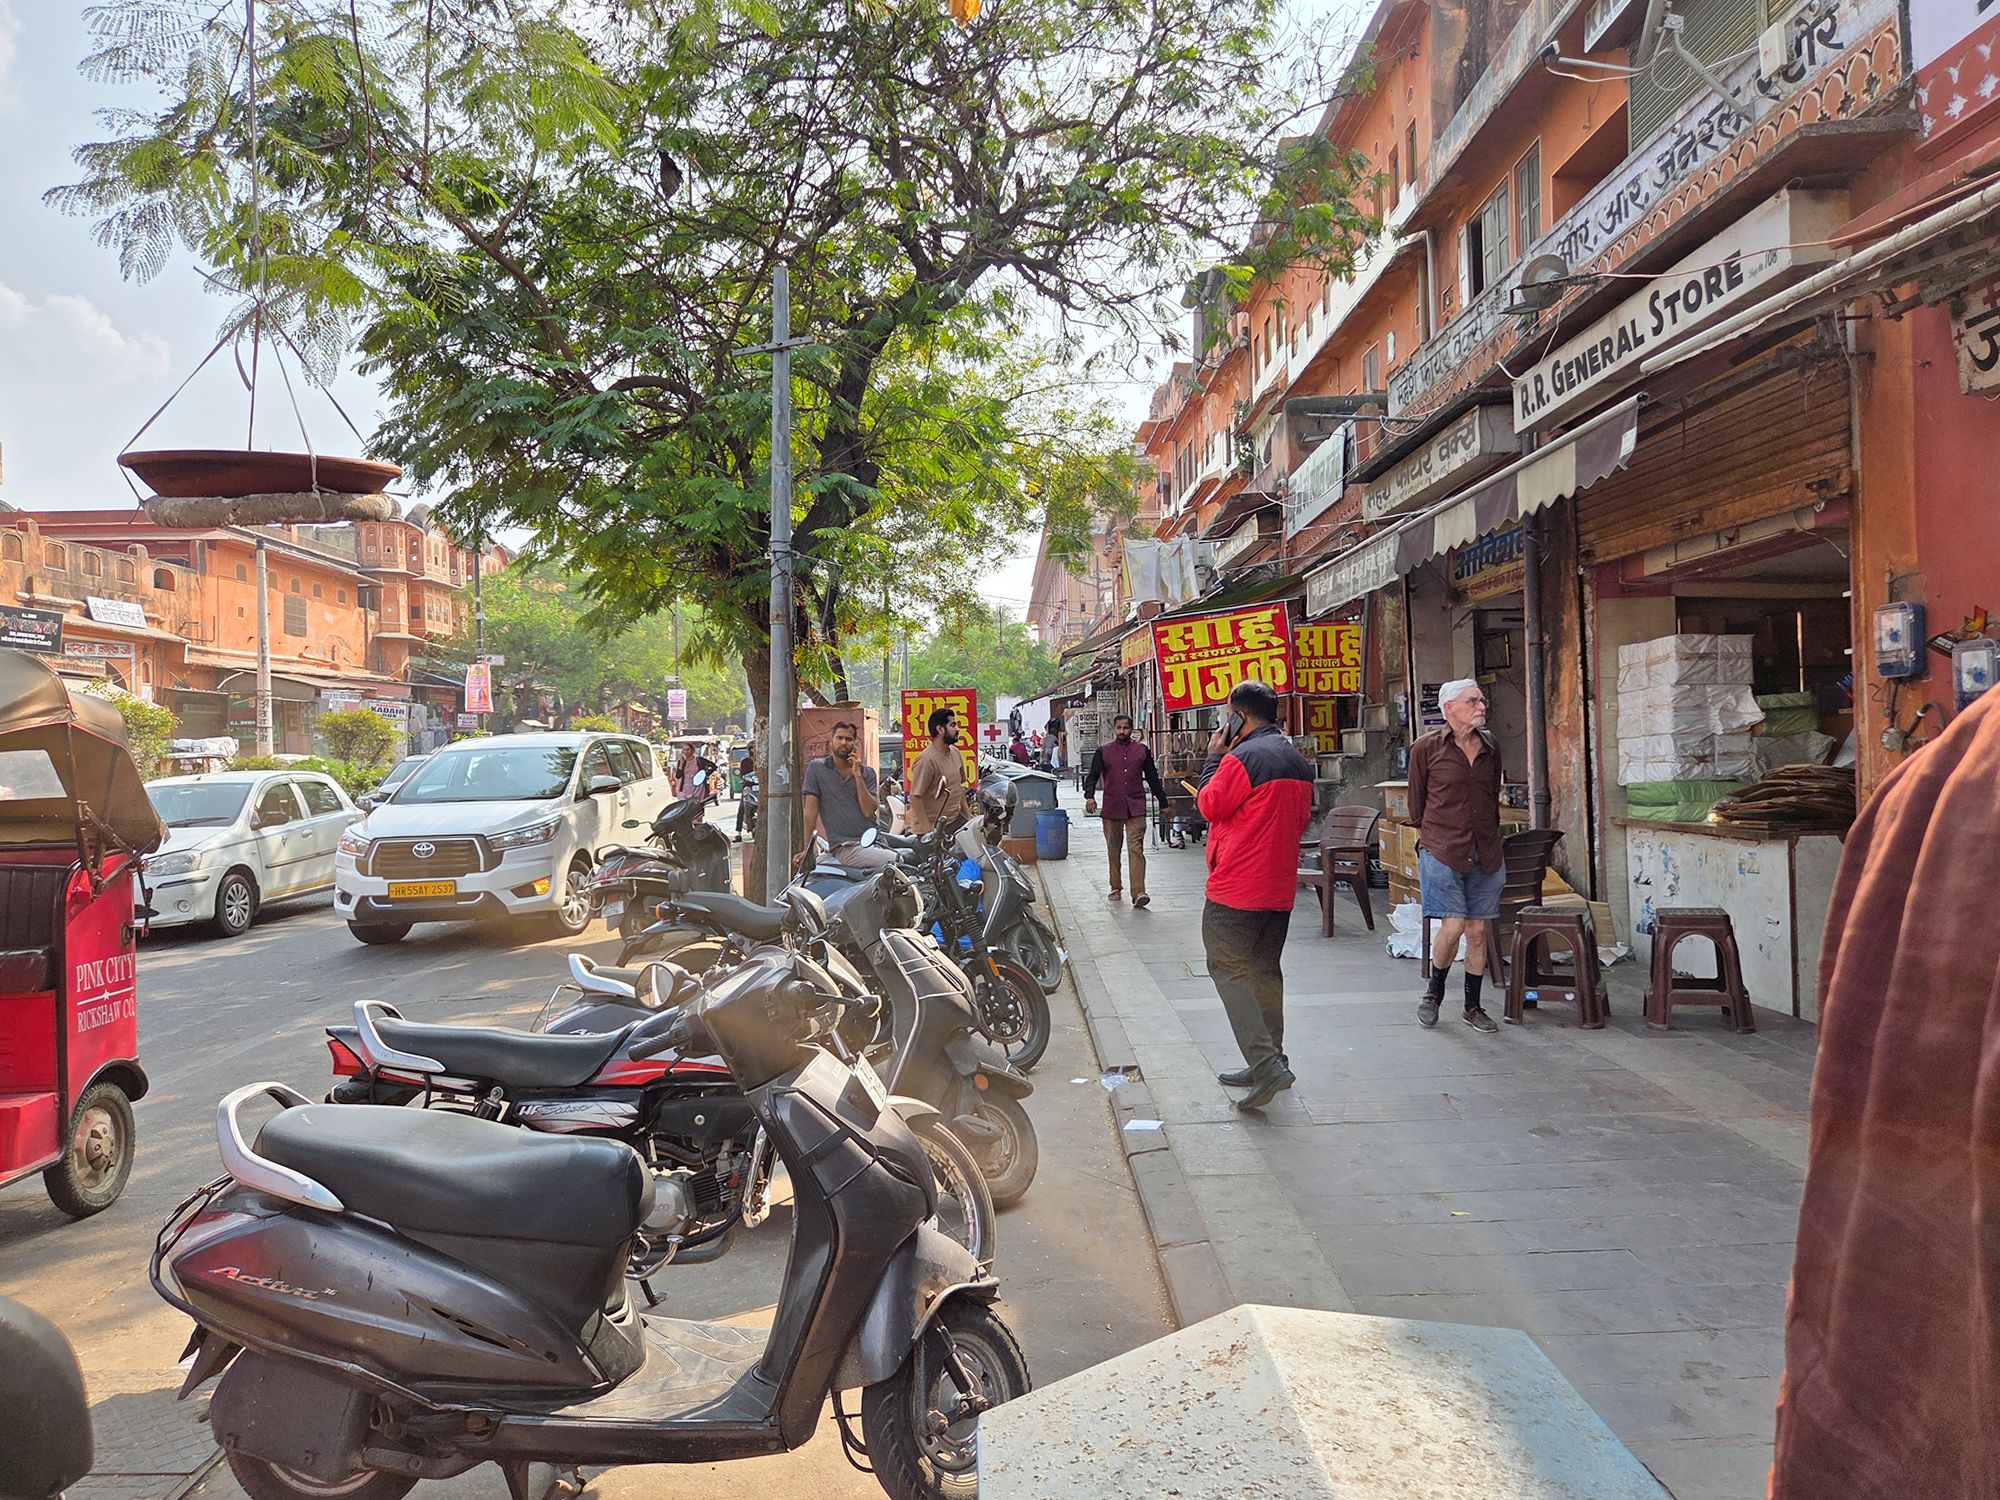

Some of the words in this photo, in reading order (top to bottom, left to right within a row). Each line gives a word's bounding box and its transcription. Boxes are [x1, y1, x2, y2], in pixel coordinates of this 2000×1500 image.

[1521, 374, 1550, 419] R.R.
[1551, 319, 1644, 397] GENERAL
[1649, 250, 1744, 337] STORE
[1156, 608, 1286, 652] साहू
[1294, 625, 1361, 666] साहू
[1163, 653, 1187, 663] की
[1164, 647, 1287, 705] गजक
[1296, 667, 1360, 692] गजक
[431, 884, 454, 895] 2537
[76, 960, 105, 992] PINK
[106, 953, 134, 984] CITY
[77, 1000, 121, 1032] RICKSHAW
[519, 1105, 543, 1116] HF
[321, 1286, 338, 1297] 3G
